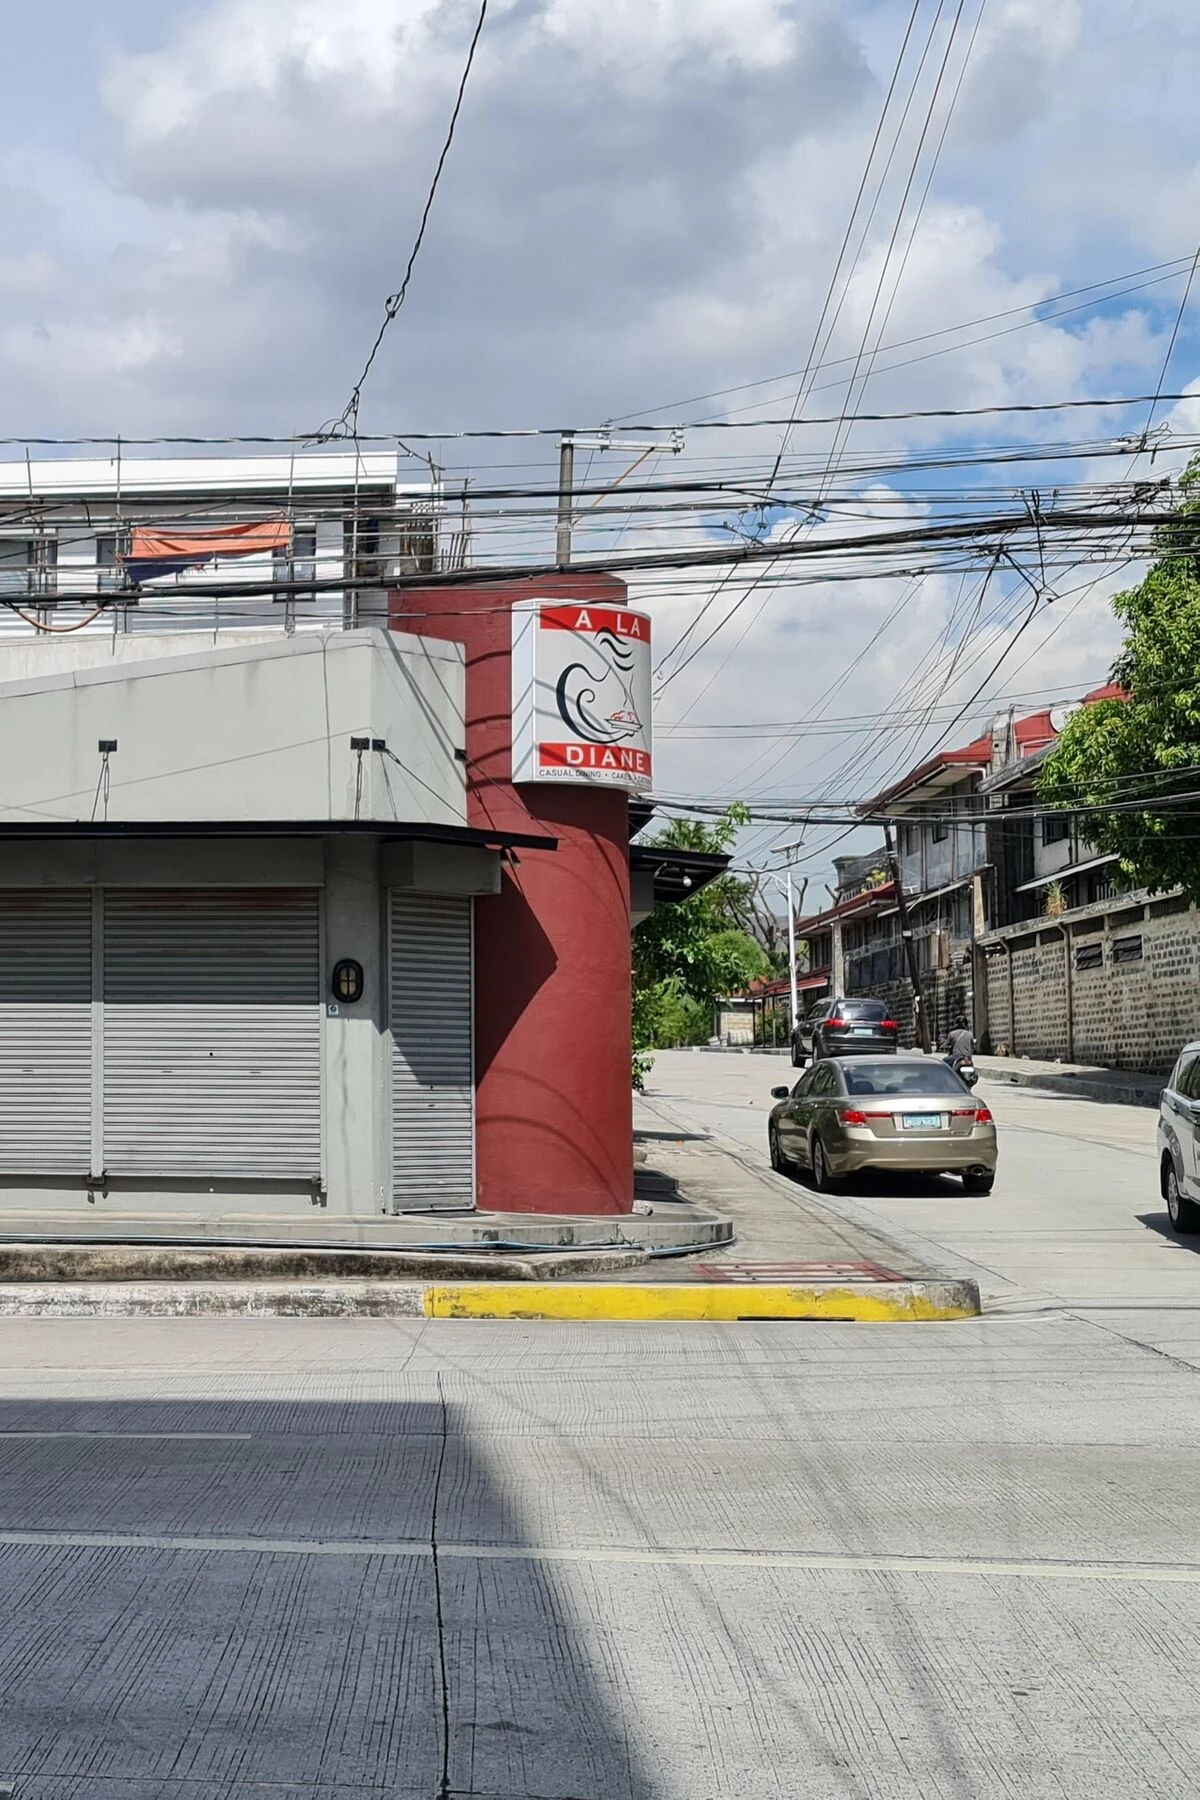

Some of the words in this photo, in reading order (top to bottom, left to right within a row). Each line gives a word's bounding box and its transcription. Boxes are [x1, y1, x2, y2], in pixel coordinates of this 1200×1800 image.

[575, 610, 593, 628] A
[616, 613, 641, 637] LA
[566, 746, 645, 771] DIANE
[539, 769, 574, 777] CASUAL
